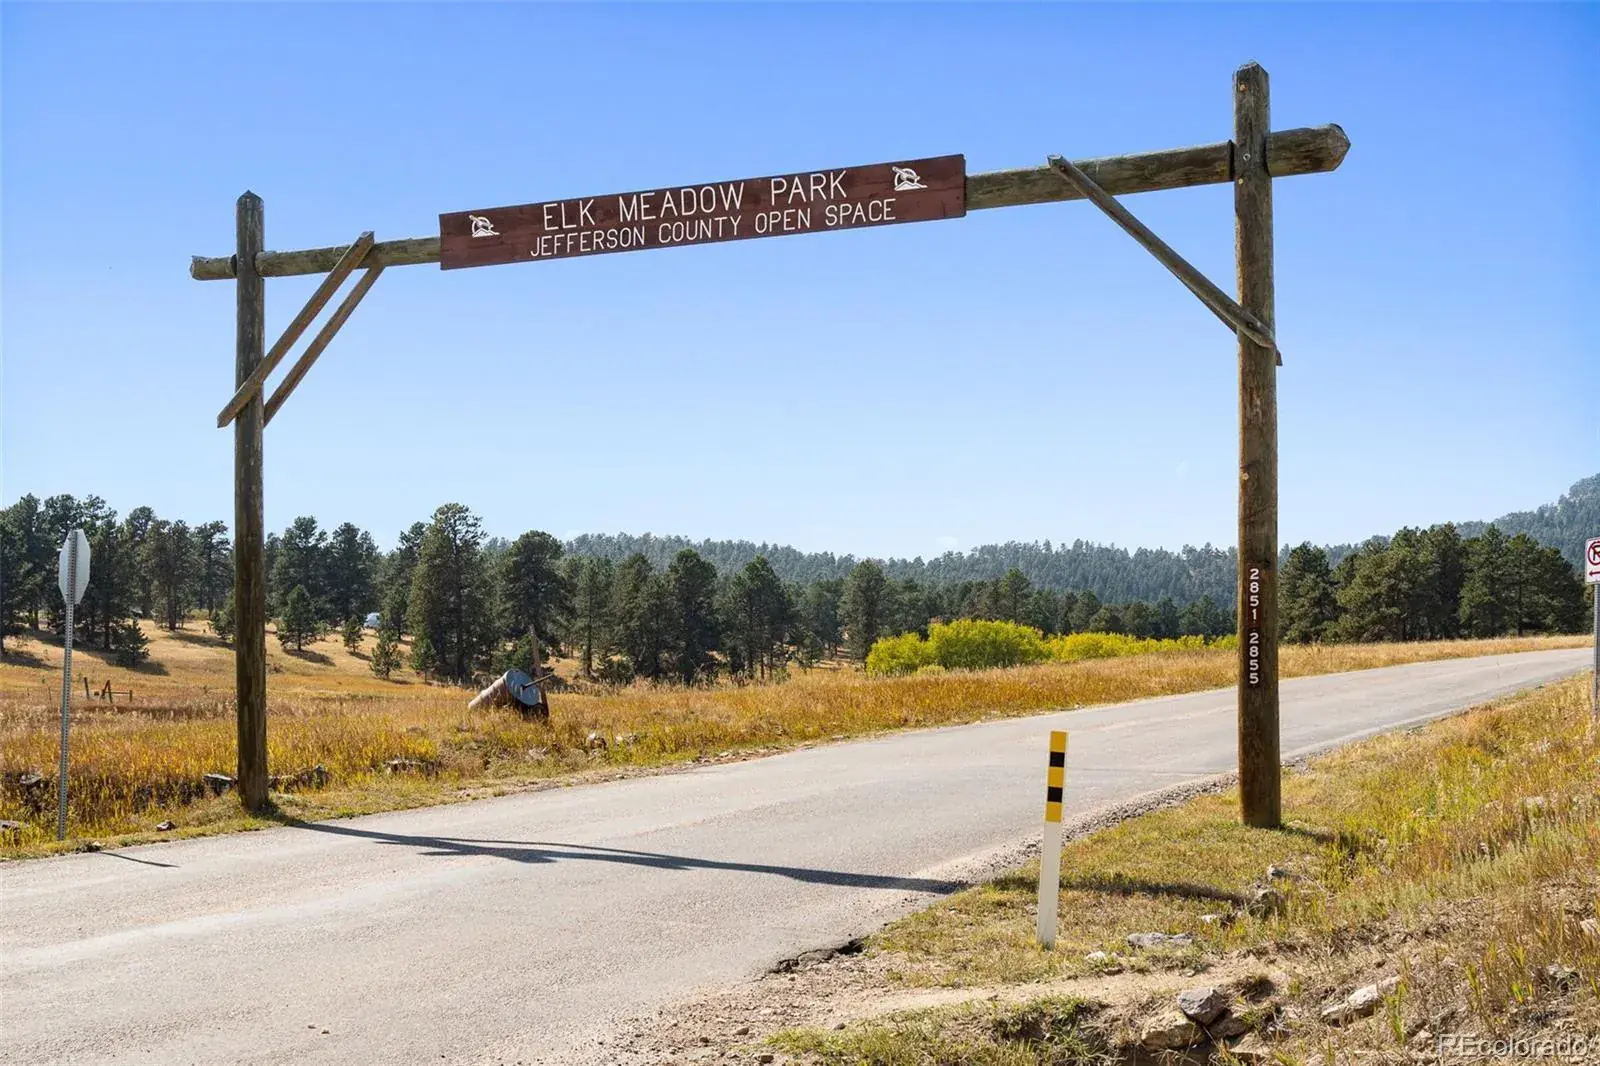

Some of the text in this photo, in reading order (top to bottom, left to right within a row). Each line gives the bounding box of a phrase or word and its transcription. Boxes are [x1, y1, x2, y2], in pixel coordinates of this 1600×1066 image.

[530, 198, 897, 257] JEFFERSON COUNTY OPEN SPACE
[543, 170, 847, 231] ELK MEADOW PARK
[1249, 568, 1260, 684] 2851 2855
